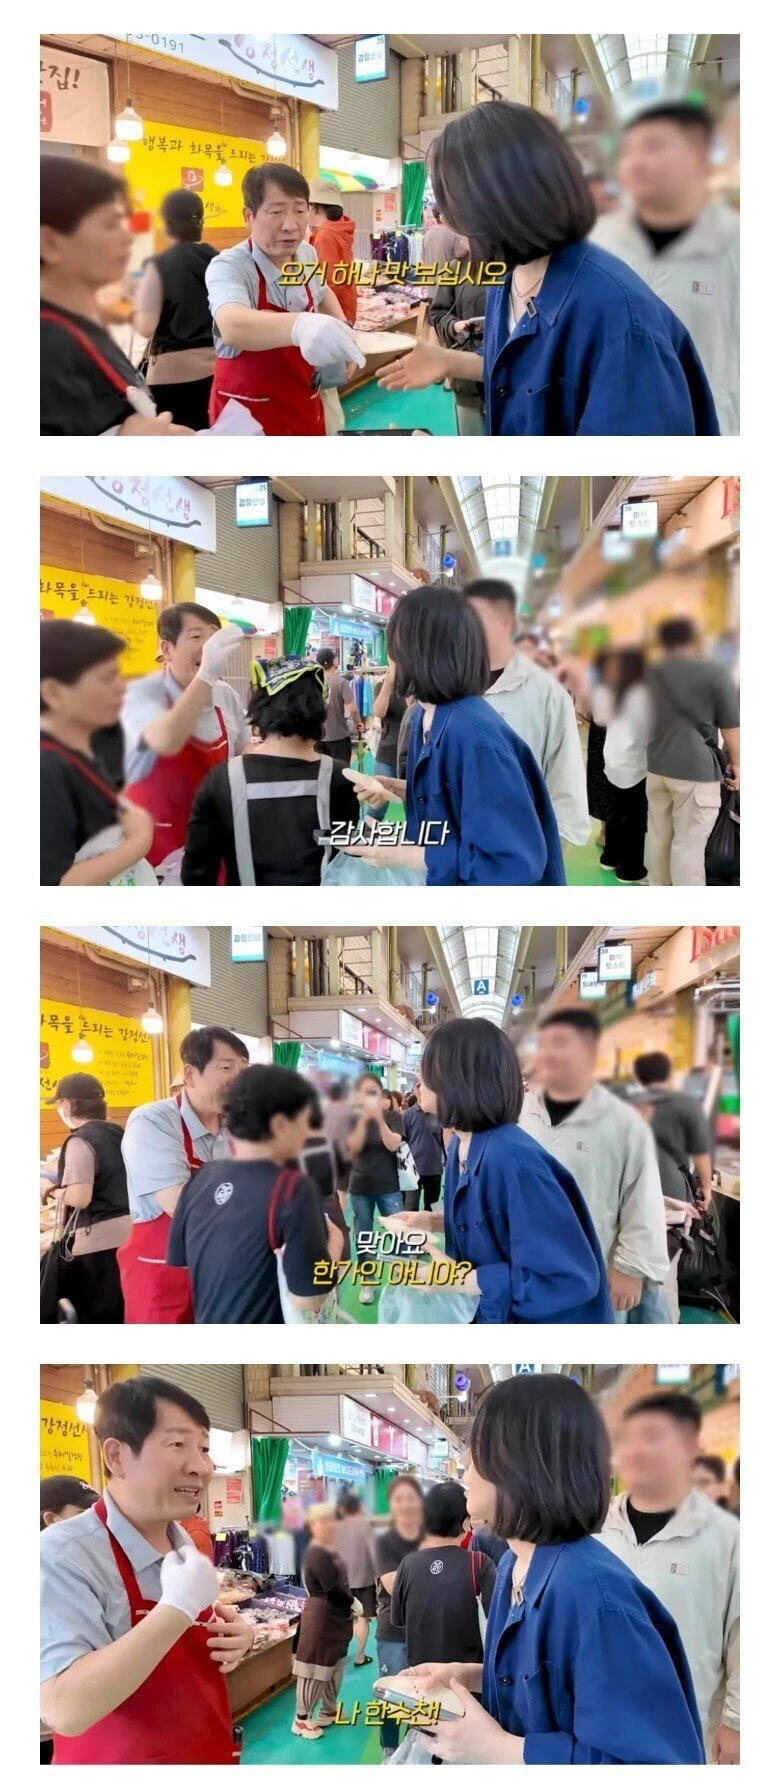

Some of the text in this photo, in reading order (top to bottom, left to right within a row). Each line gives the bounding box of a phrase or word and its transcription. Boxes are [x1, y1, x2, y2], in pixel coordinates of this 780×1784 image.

[127, 34, 184, 53] -0191
[40, 60, 81, 91] 집!
[143, 136, 183, 153] 행복과
[190, 142, 226, 162] 화목을
[87, 588, 119, 605] 드리는
[125, 595, 155, 610] 강정선
[477, 980, 486, 992] A
[81, 1021, 113, 1039] 드리는
